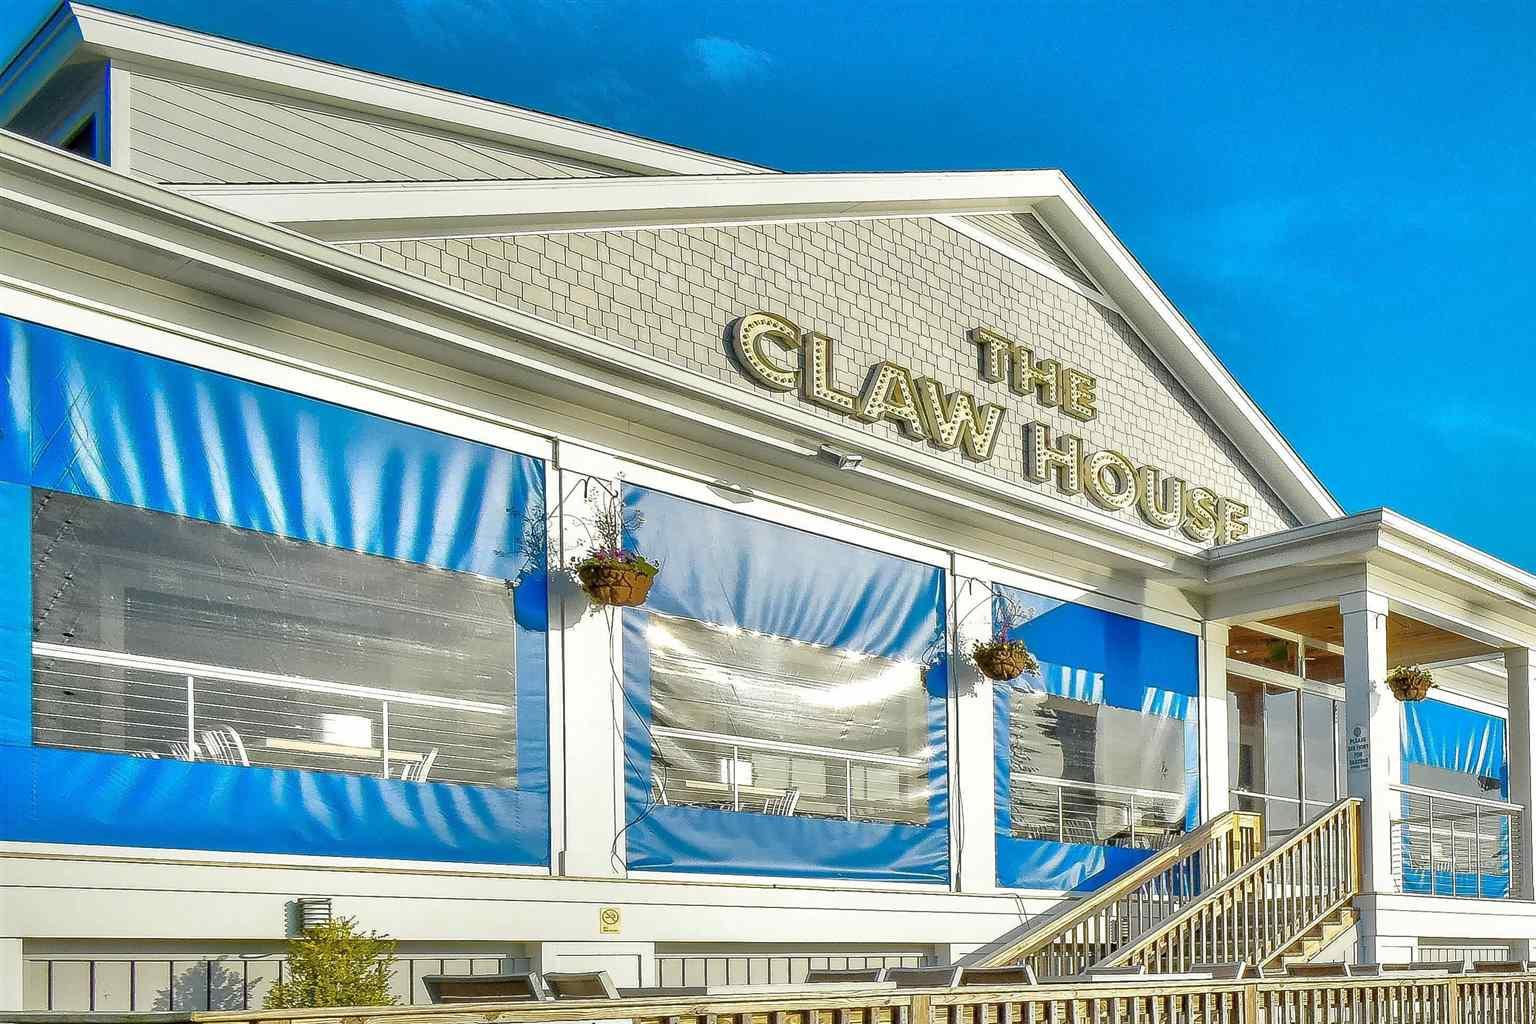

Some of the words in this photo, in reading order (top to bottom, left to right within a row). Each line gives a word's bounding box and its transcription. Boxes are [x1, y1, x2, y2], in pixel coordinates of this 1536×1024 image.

[726, 311, 1006, 462] CLAW
[1023, 420, 1249, 545] HOUSE
[968, 326, 1097, 421] THE
